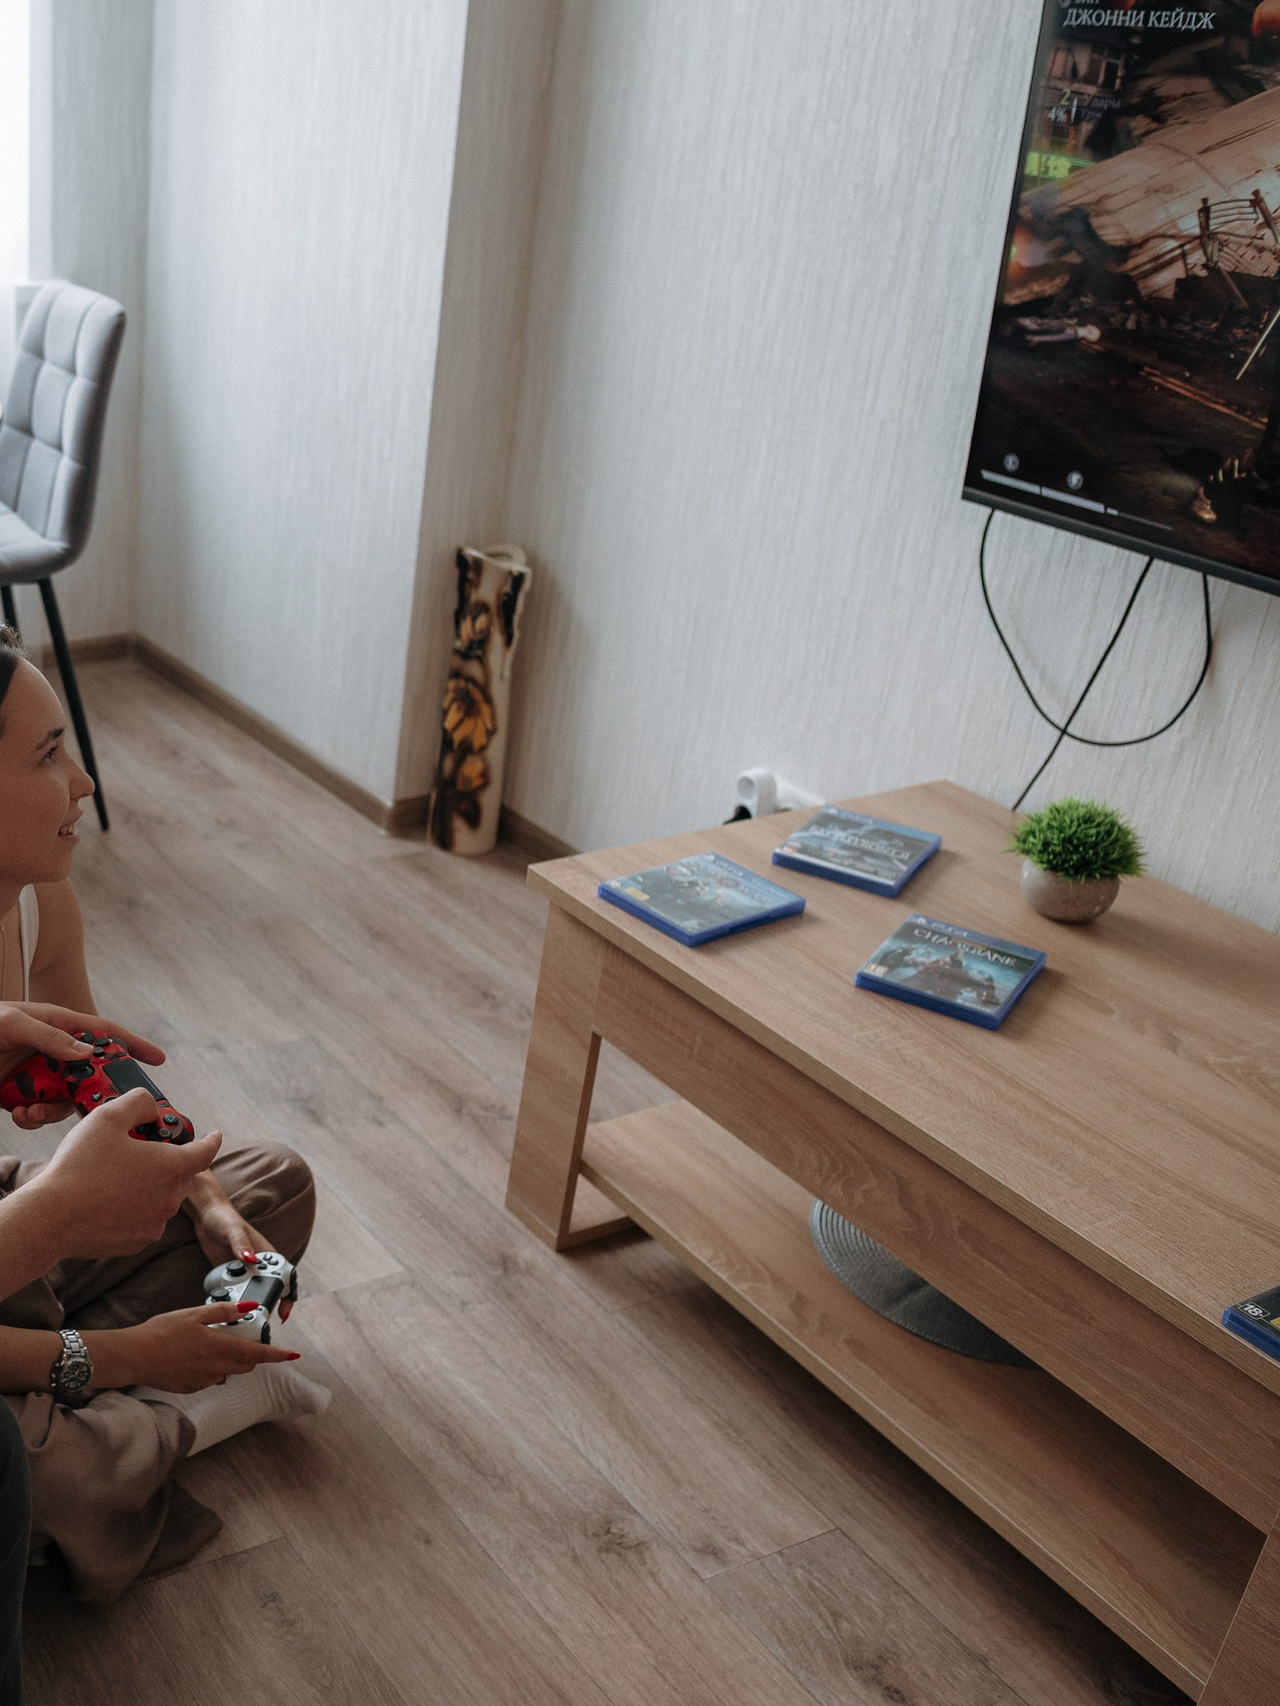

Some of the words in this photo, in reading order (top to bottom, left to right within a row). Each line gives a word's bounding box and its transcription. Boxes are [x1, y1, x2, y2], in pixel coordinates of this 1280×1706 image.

[1062, 8, 1145, 27] ДЖОННИ
[1147, 7, 1216, 32] КЕЙДЖ
[1060, 88, 1070, 105] 2
